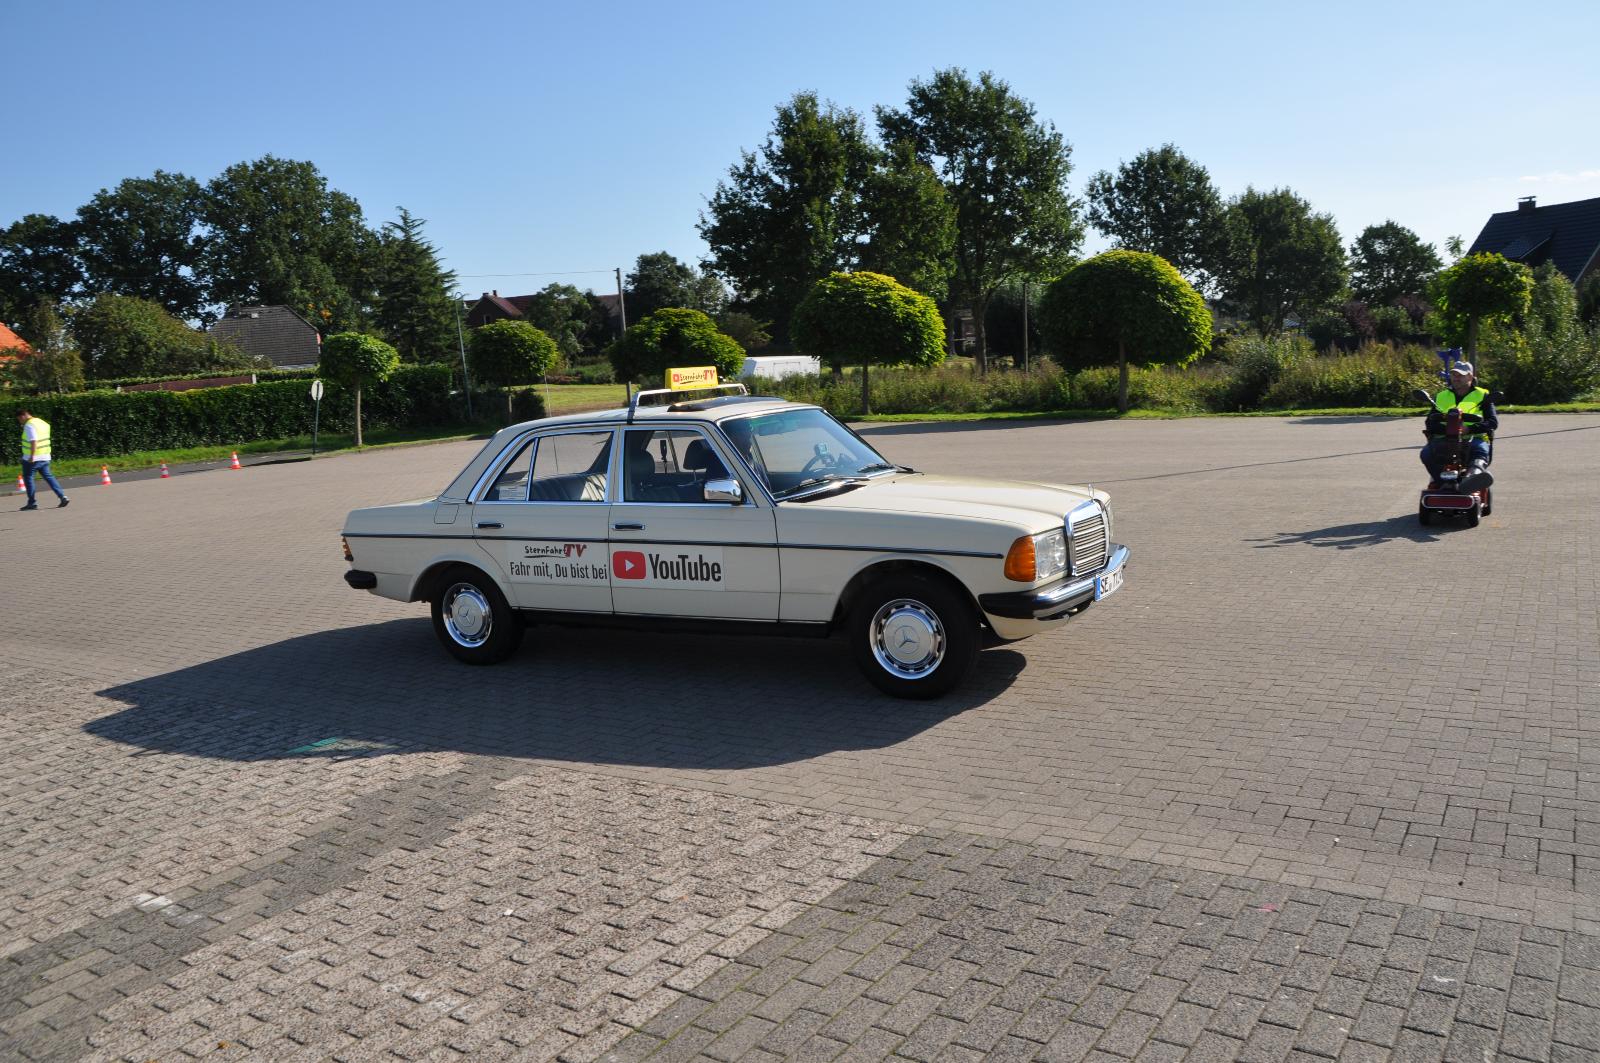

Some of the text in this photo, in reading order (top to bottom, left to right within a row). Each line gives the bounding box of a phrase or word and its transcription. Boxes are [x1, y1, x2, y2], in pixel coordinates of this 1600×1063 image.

[510, 553, 722, 582] Fahr mit, Du bist bei YouTube
